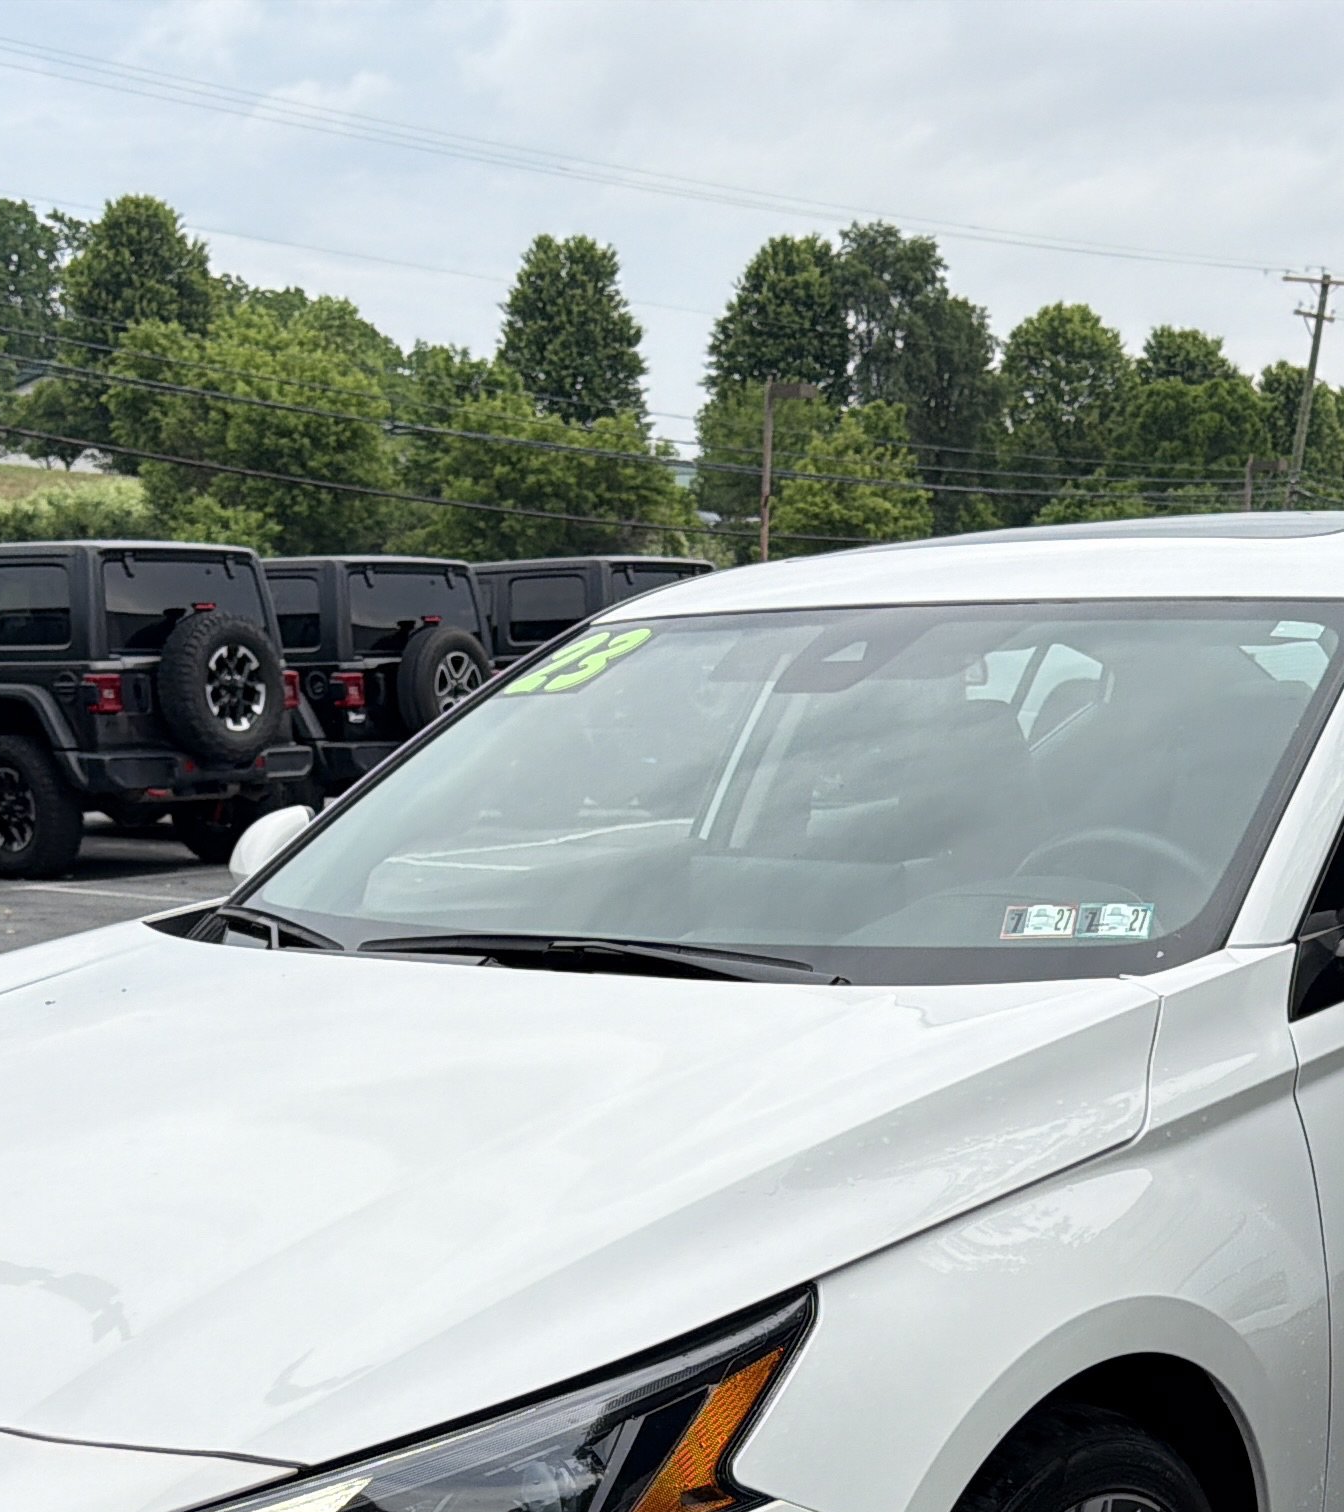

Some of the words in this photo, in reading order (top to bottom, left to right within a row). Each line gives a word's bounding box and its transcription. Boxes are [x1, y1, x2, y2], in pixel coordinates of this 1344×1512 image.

[503, 627, 653, 695] 23
[1053, 908, 1073, 932] 27
[1129, 908, 1148, 932] 27
